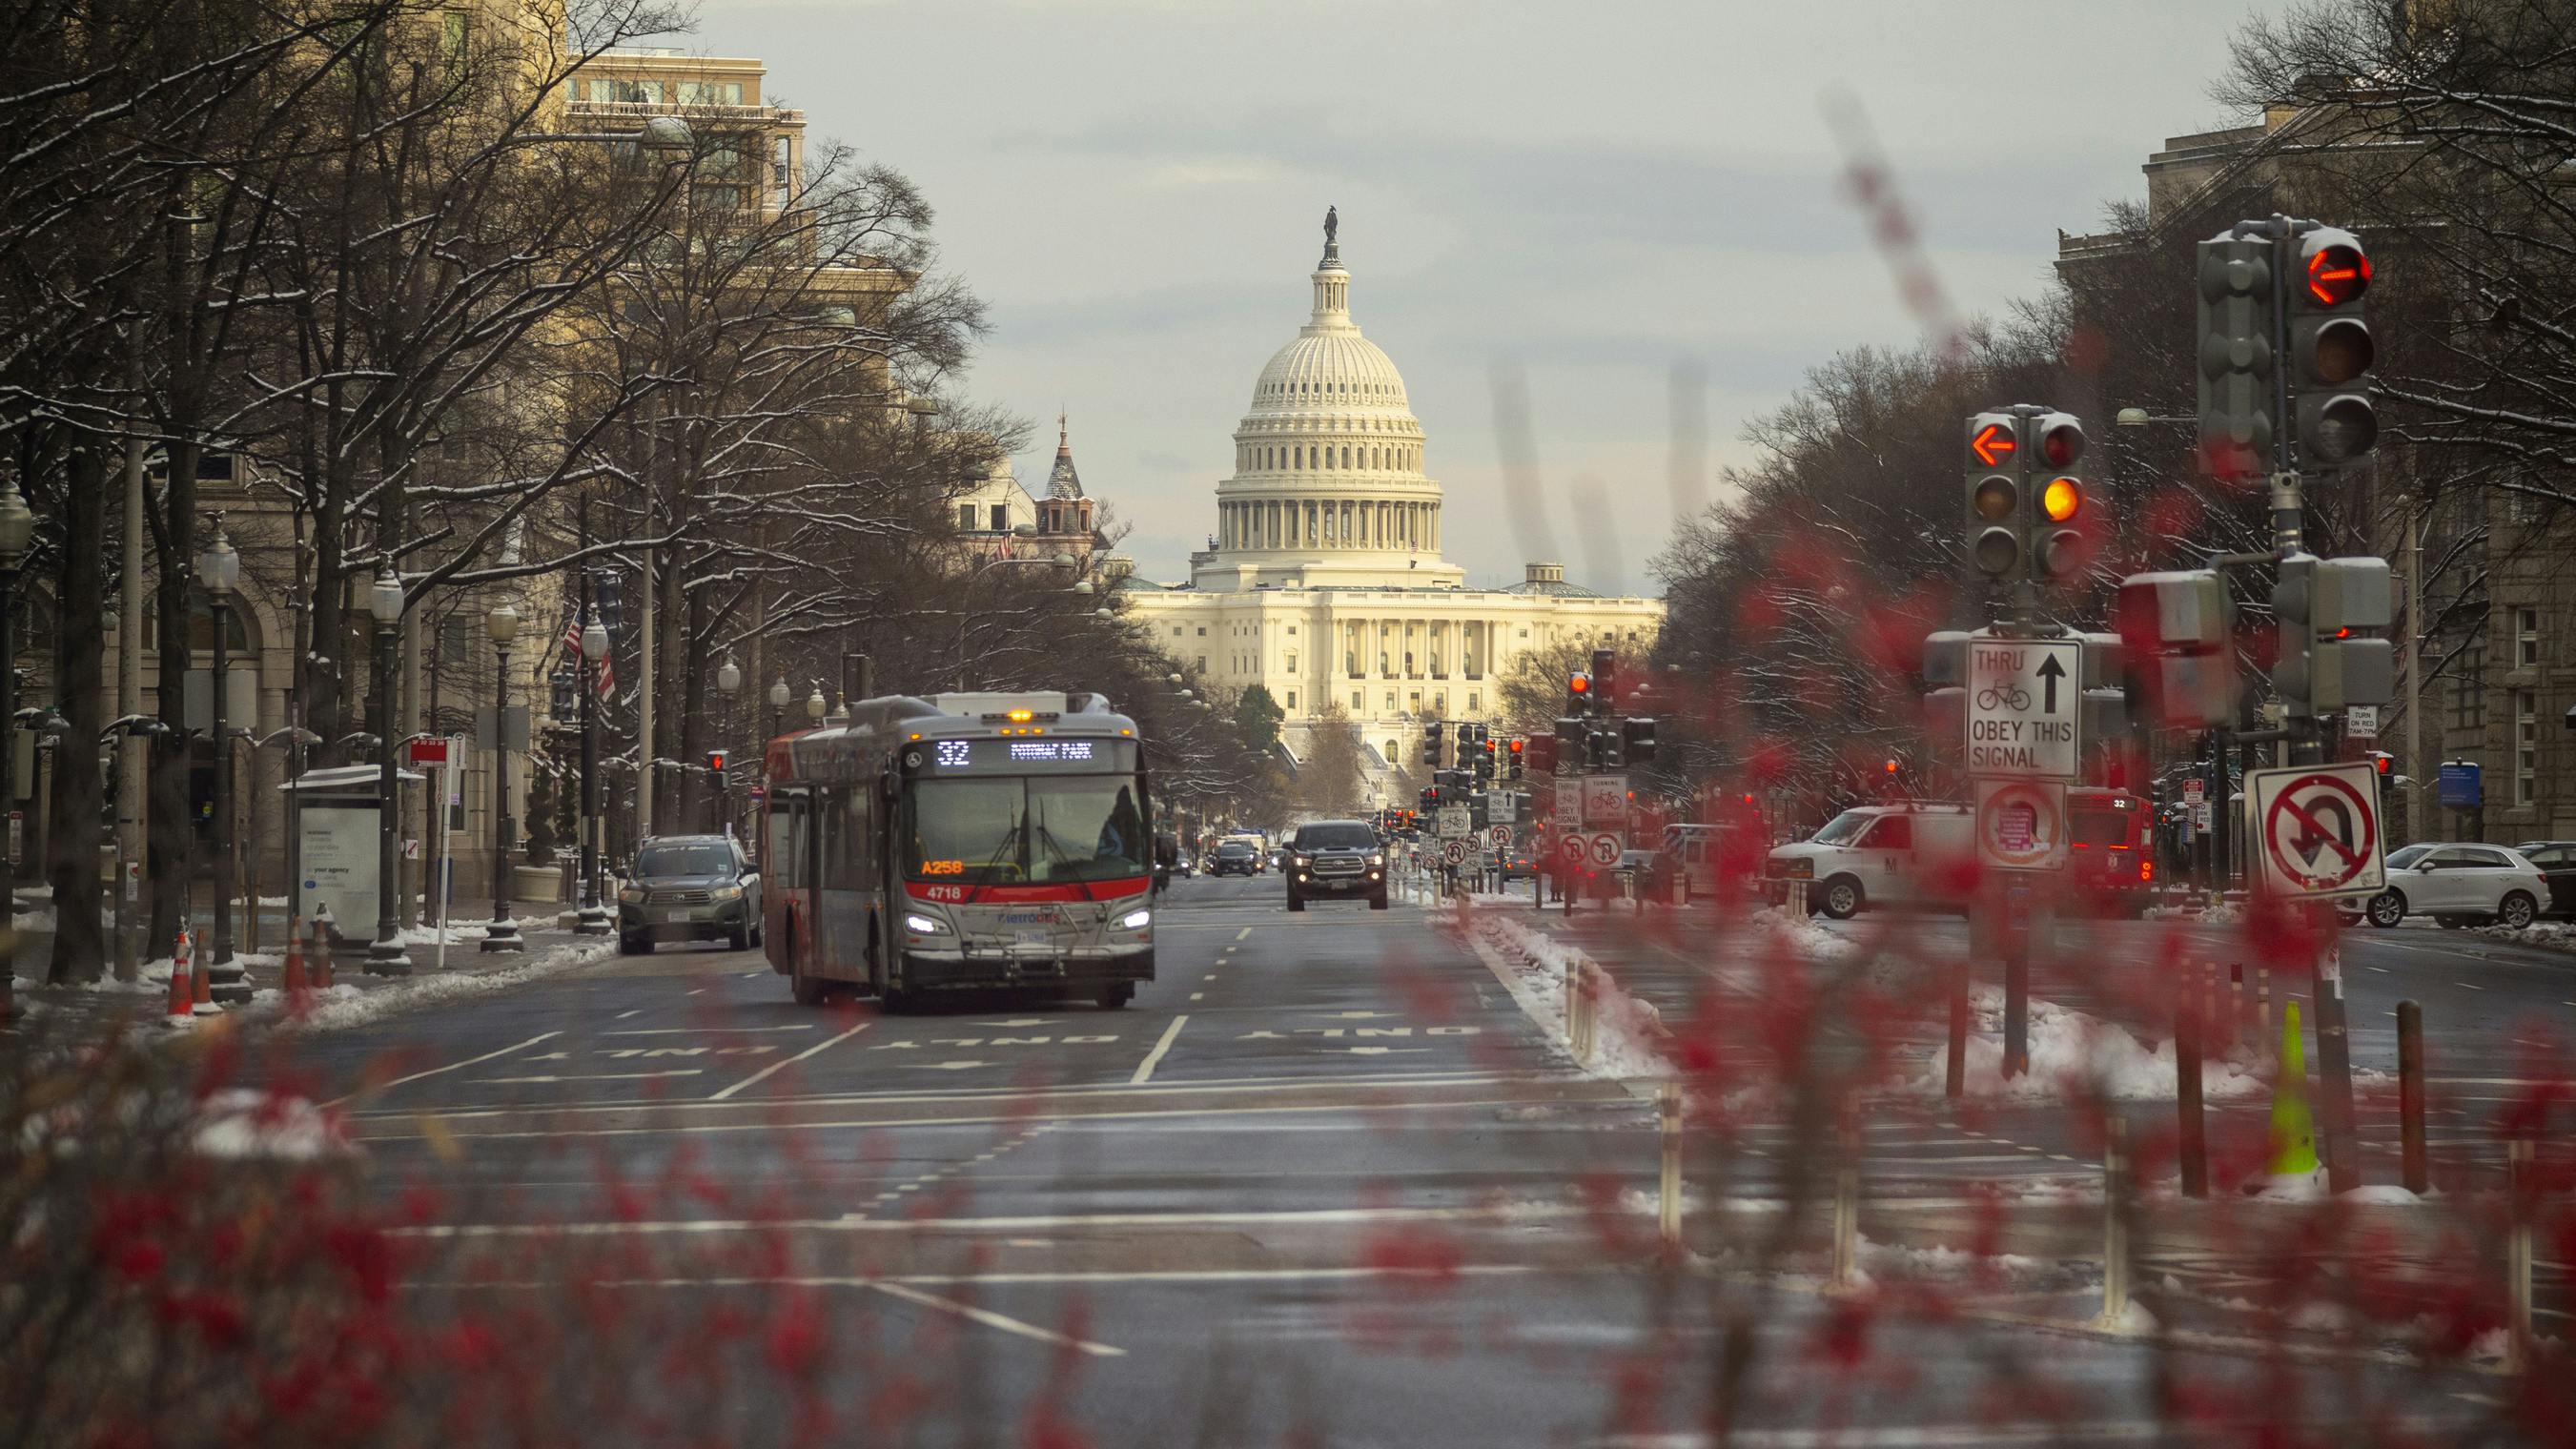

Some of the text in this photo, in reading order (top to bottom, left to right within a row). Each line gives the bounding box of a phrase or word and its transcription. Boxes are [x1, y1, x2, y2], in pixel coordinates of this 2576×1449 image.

[1975, 650, 2025, 671] THRU
[1973, 720, 2072, 742] OBEY THIS
[937, 741, 970, 765] 32
[1973, 746, 2040, 768] SIGNAL
[2114, 799, 2125, 808] 32
[1557, 815, 1580, 824] SIGNAL
[921, 860, 964, 875] A258
[927, 887, 961, 900] 4718
